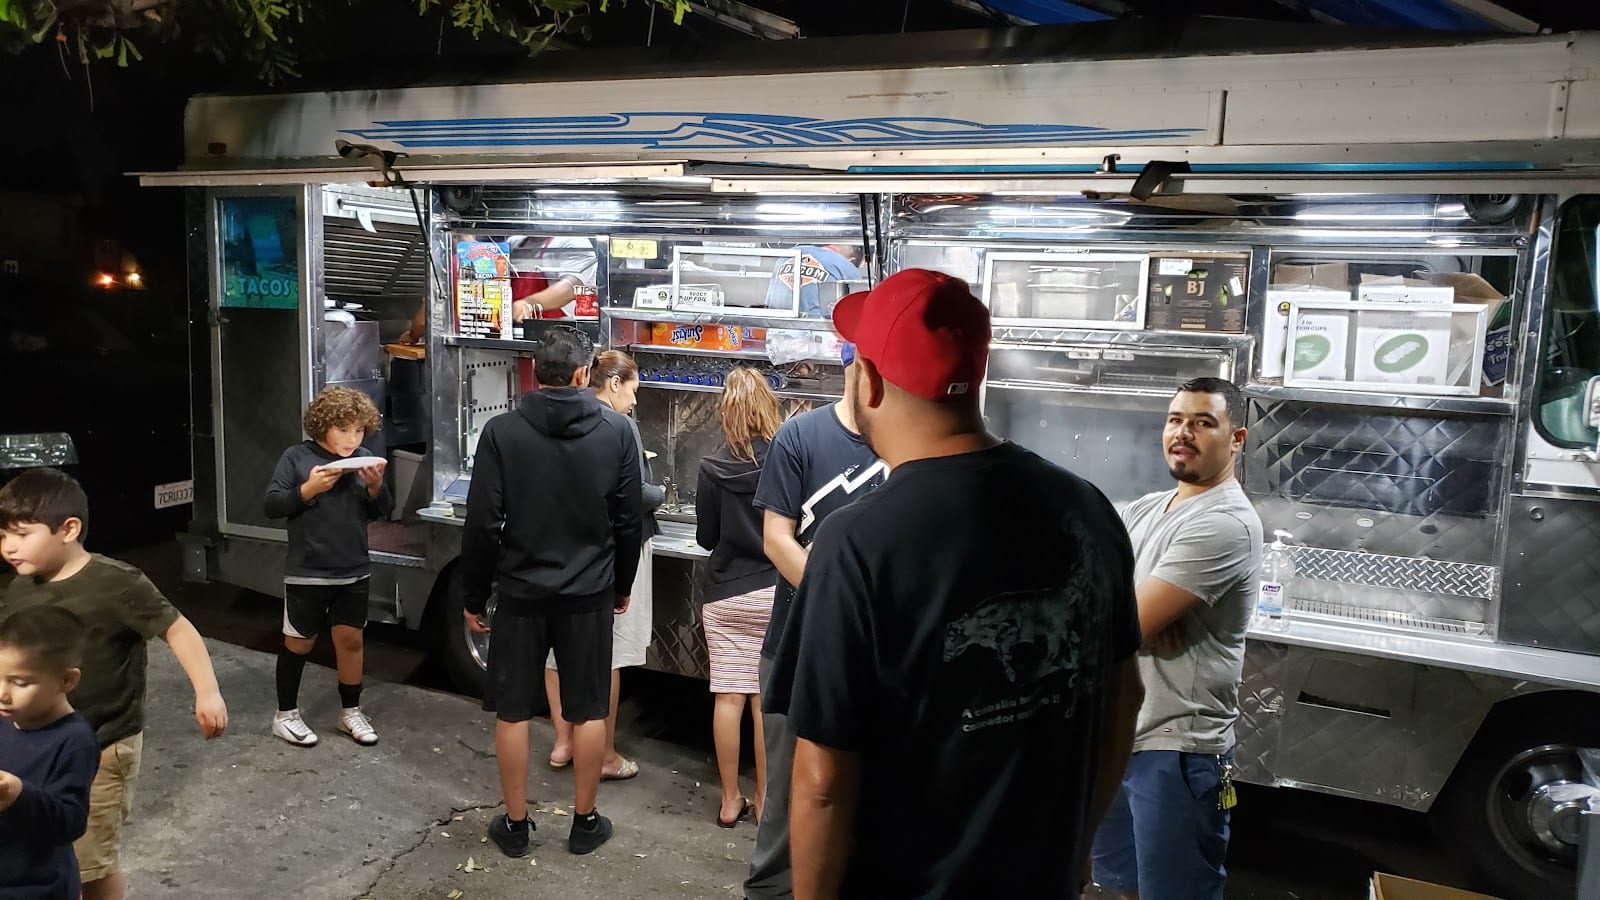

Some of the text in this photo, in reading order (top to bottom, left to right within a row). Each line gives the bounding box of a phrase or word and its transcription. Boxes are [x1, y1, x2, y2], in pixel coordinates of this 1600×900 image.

[777, 263, 826, 282] VOCOM
[238, 278, 291, 297] TACOS
[574, 286, 598, 296] TIPS
[1186, 280, 1206, 297] BJ
[670, 324, 703, 343] Sunkist
[158, 487, 193, 505] 7CRU337
